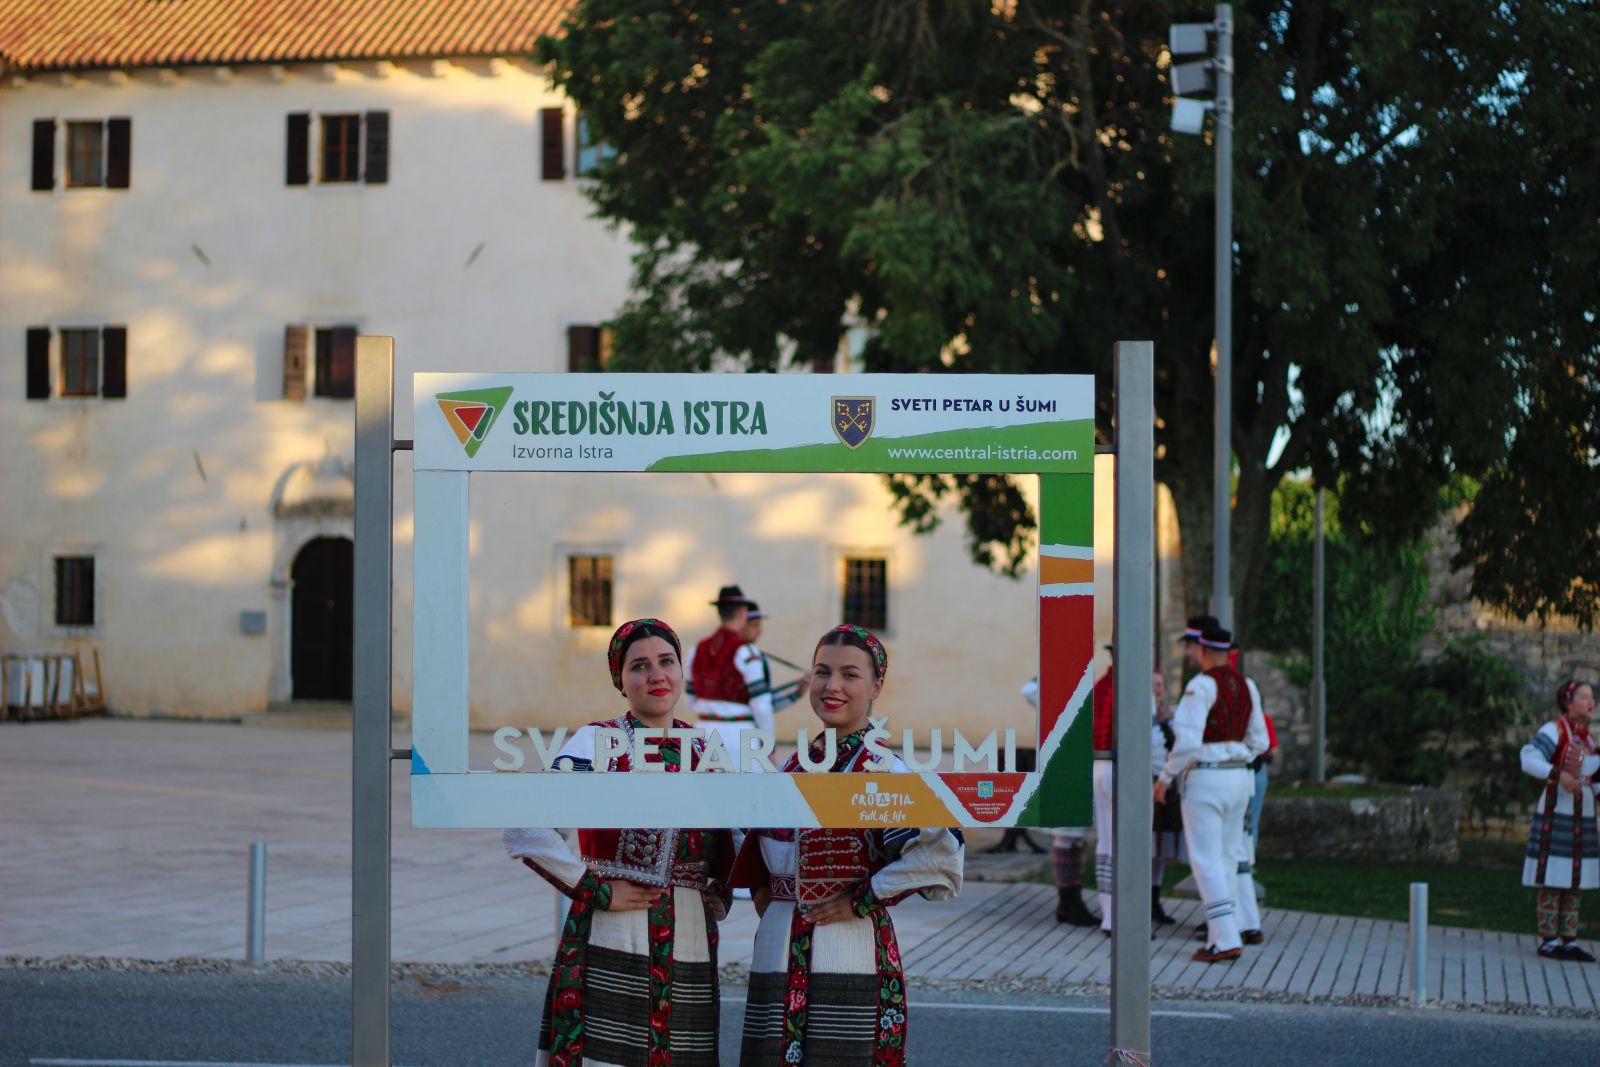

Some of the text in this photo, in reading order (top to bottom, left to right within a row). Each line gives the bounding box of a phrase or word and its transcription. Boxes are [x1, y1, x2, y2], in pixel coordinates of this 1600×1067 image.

[891, 395, 1057, 413] SVETI PETAR U ŠUMI
[512, 390, 768, 436] SREDIŠNJA ISTRA
[512, 444, 613, 460] Izvorna Istra
[887, 444, 1077, 461] www.central-istria.com
[493, 715, 1017, 773] SV. PETAR U ŠUMI
[851, 792, 915, 807] CROATIA
